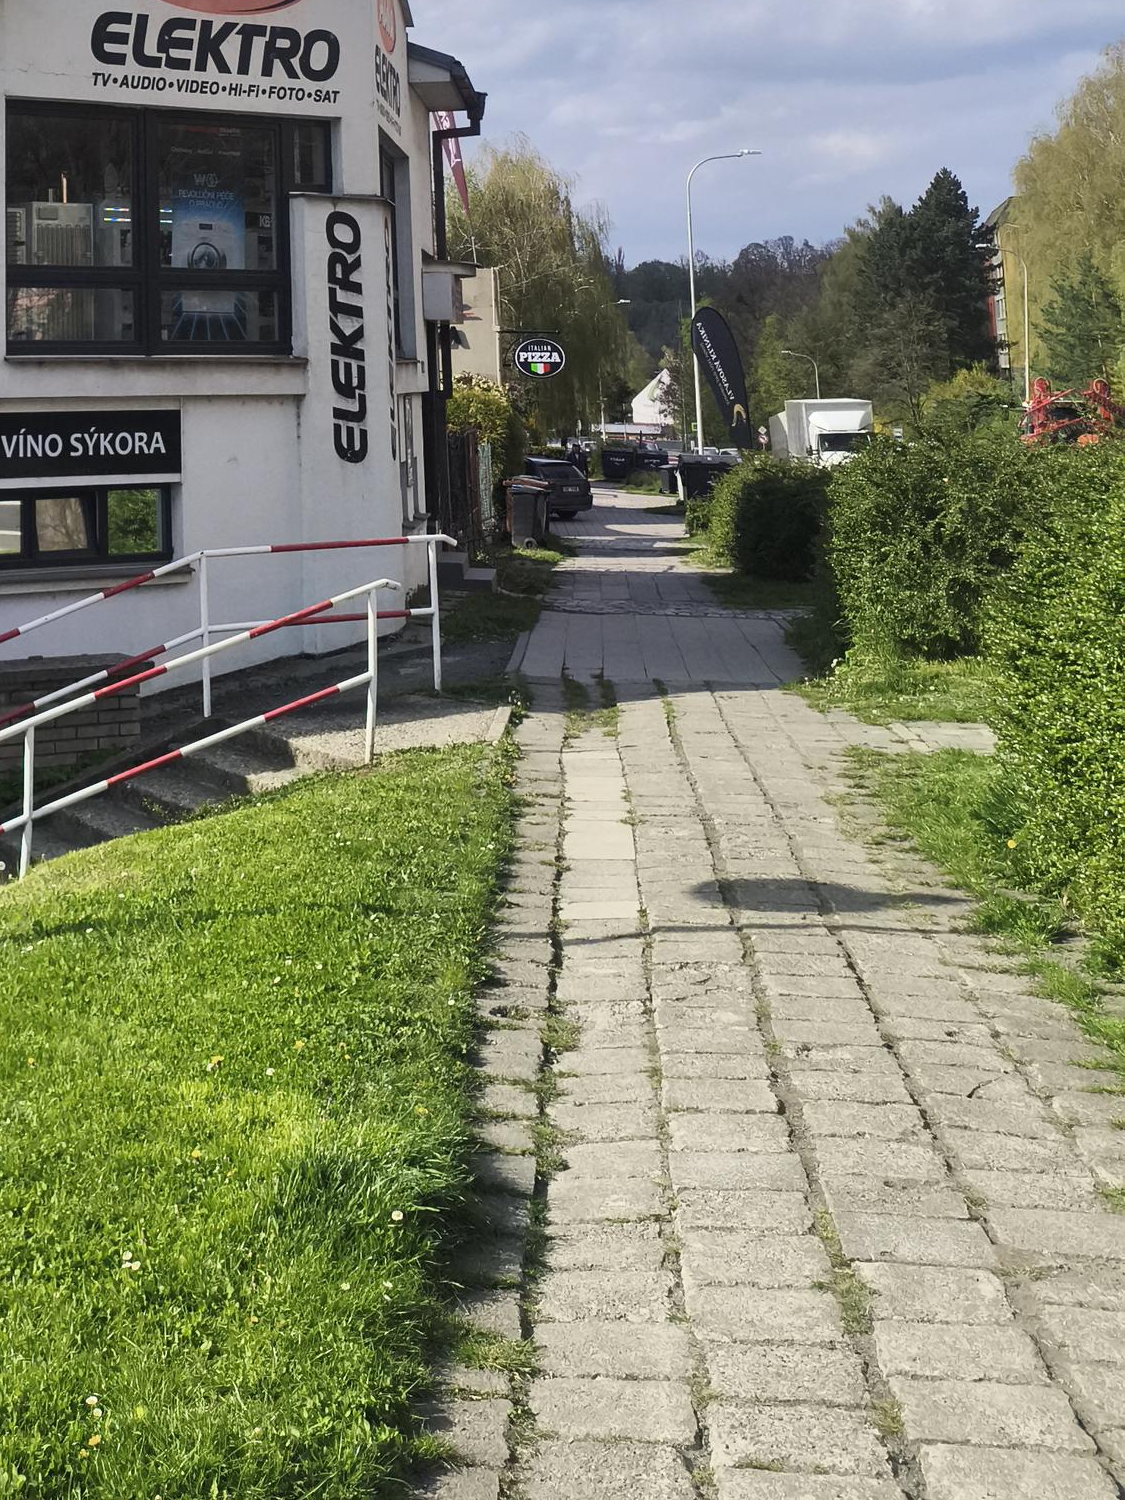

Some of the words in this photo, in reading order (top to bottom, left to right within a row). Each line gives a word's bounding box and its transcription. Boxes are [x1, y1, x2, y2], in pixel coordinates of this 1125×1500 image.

[90, 11, 341, 82] ELEKTRO
[91, 72, 113, 88] TV
[119, 76, 167, 92] AUDIO
[175, 79, 220, 96] VIDEO
[228, 82, 261, 99] Hi-Fi
[268, 86, 306, 102] FOTO
[313, 89, 341, 105] SAT
[325, 210, 369, 464] ELEKTRO
[519, 352, 562, 363] PIZZA
[1, 427, 63, 459] VÍNO
[70, 426, 167, 458] SÝKORA
